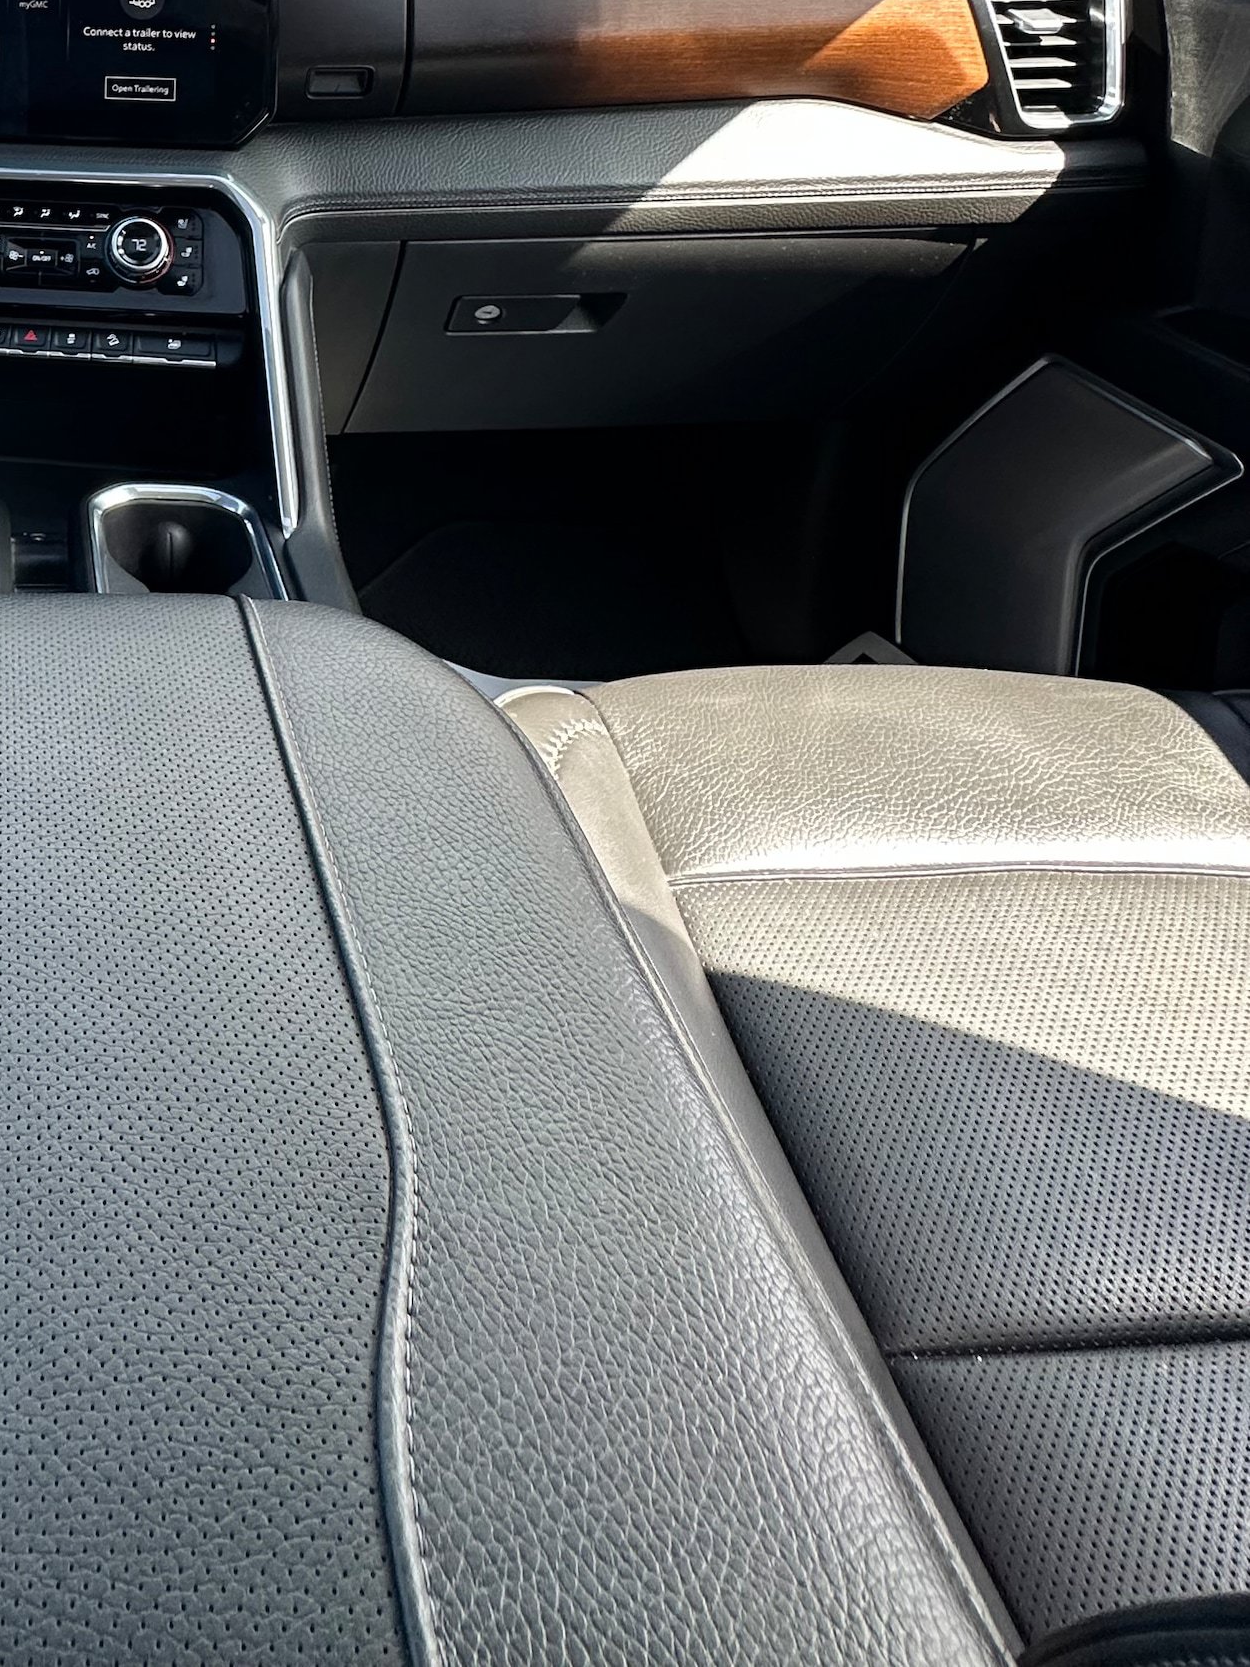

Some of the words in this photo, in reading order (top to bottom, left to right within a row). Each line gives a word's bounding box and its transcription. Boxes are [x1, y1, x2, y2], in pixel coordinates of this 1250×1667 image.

[19, 0, 48, 9] myGMC
[83, 26, 123, 37] Connect
[125, 29, 132, 37] a
[132, 27, 161, 38] trailer
[162, 29, 173, 39] to
[174, 29, 197, 39] view
[123, 42, 156, 52] status.
[112, 84, 133, 94] Open
[134, 84, 169, 95] Trailering
[131, 238, 147, 252] 72
